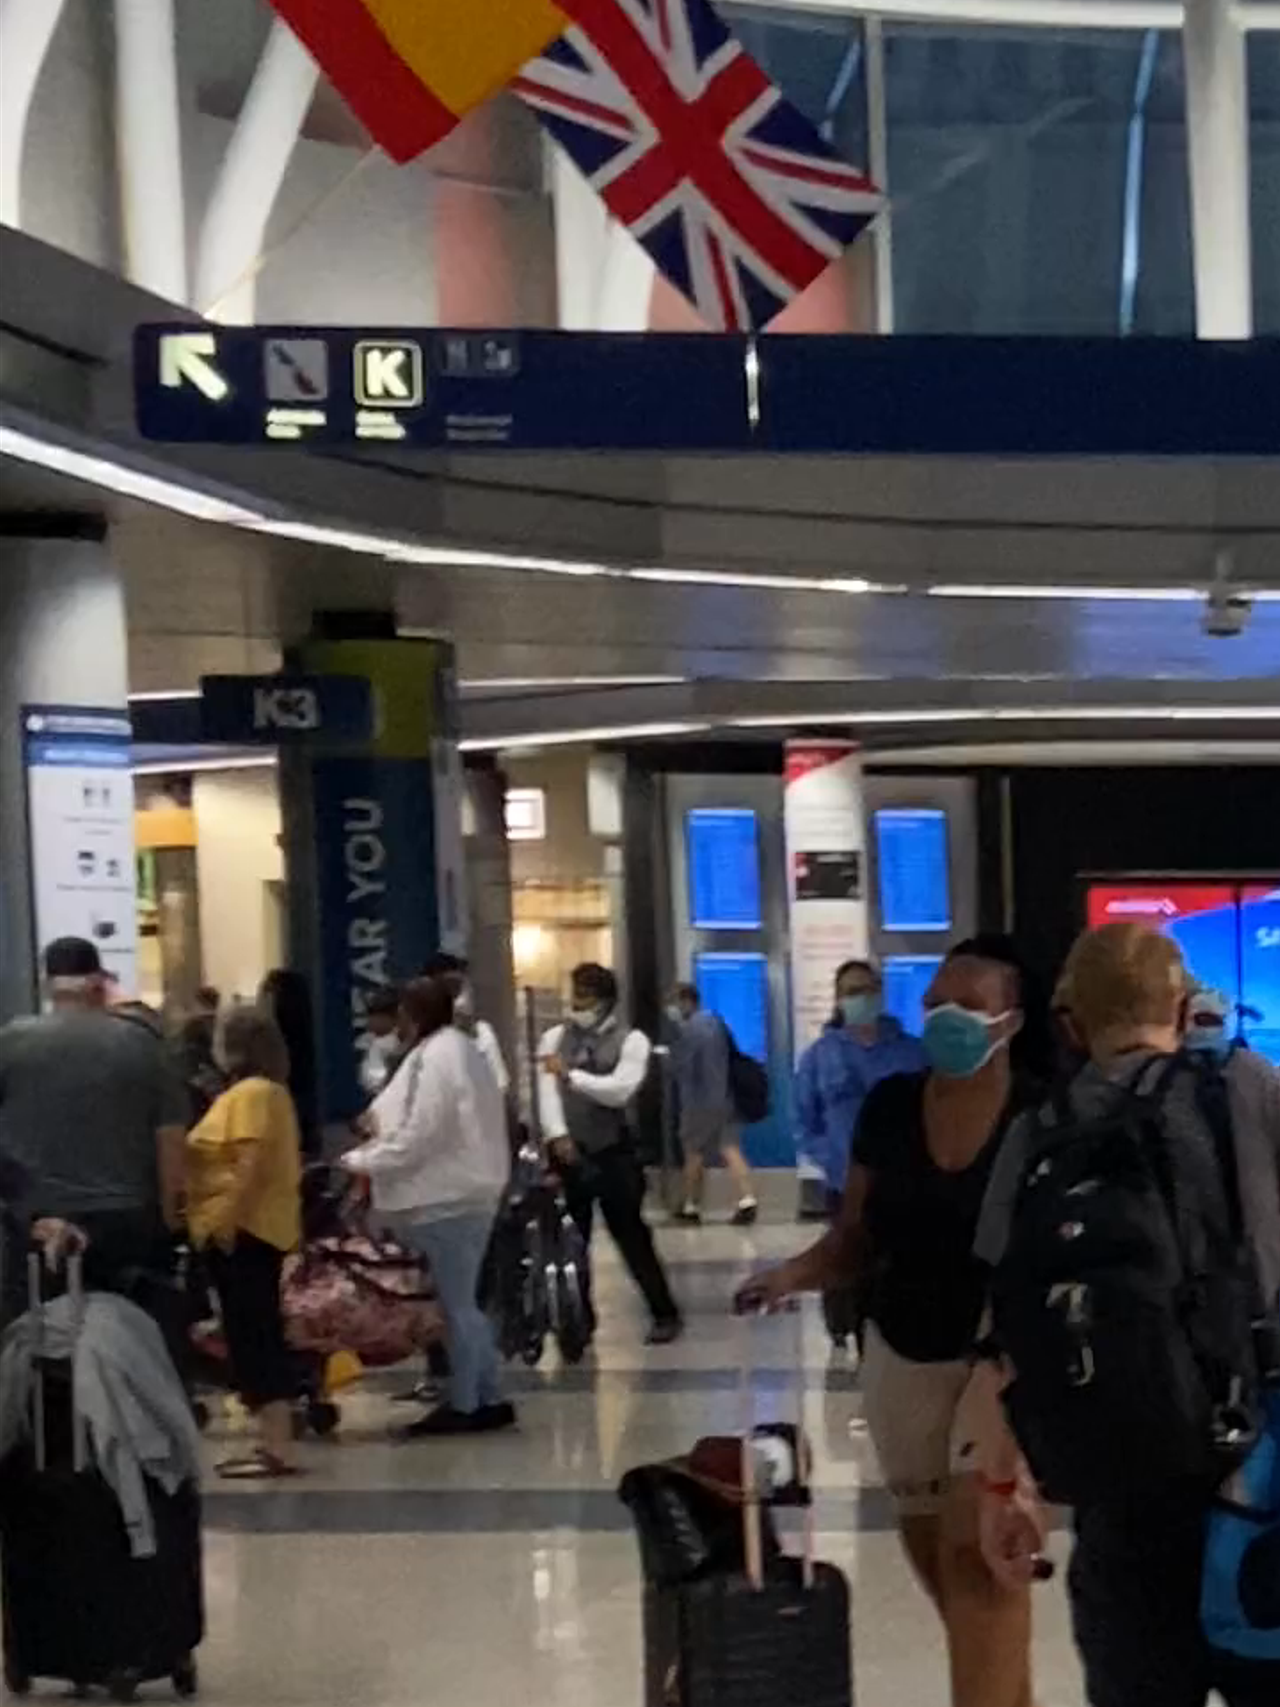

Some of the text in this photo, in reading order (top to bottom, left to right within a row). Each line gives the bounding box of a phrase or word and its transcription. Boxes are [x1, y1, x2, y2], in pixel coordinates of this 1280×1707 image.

[365, 348, 409, 397] K
[253, 688, 320, 730] K3
[343, 798, 388, 904] YOU
